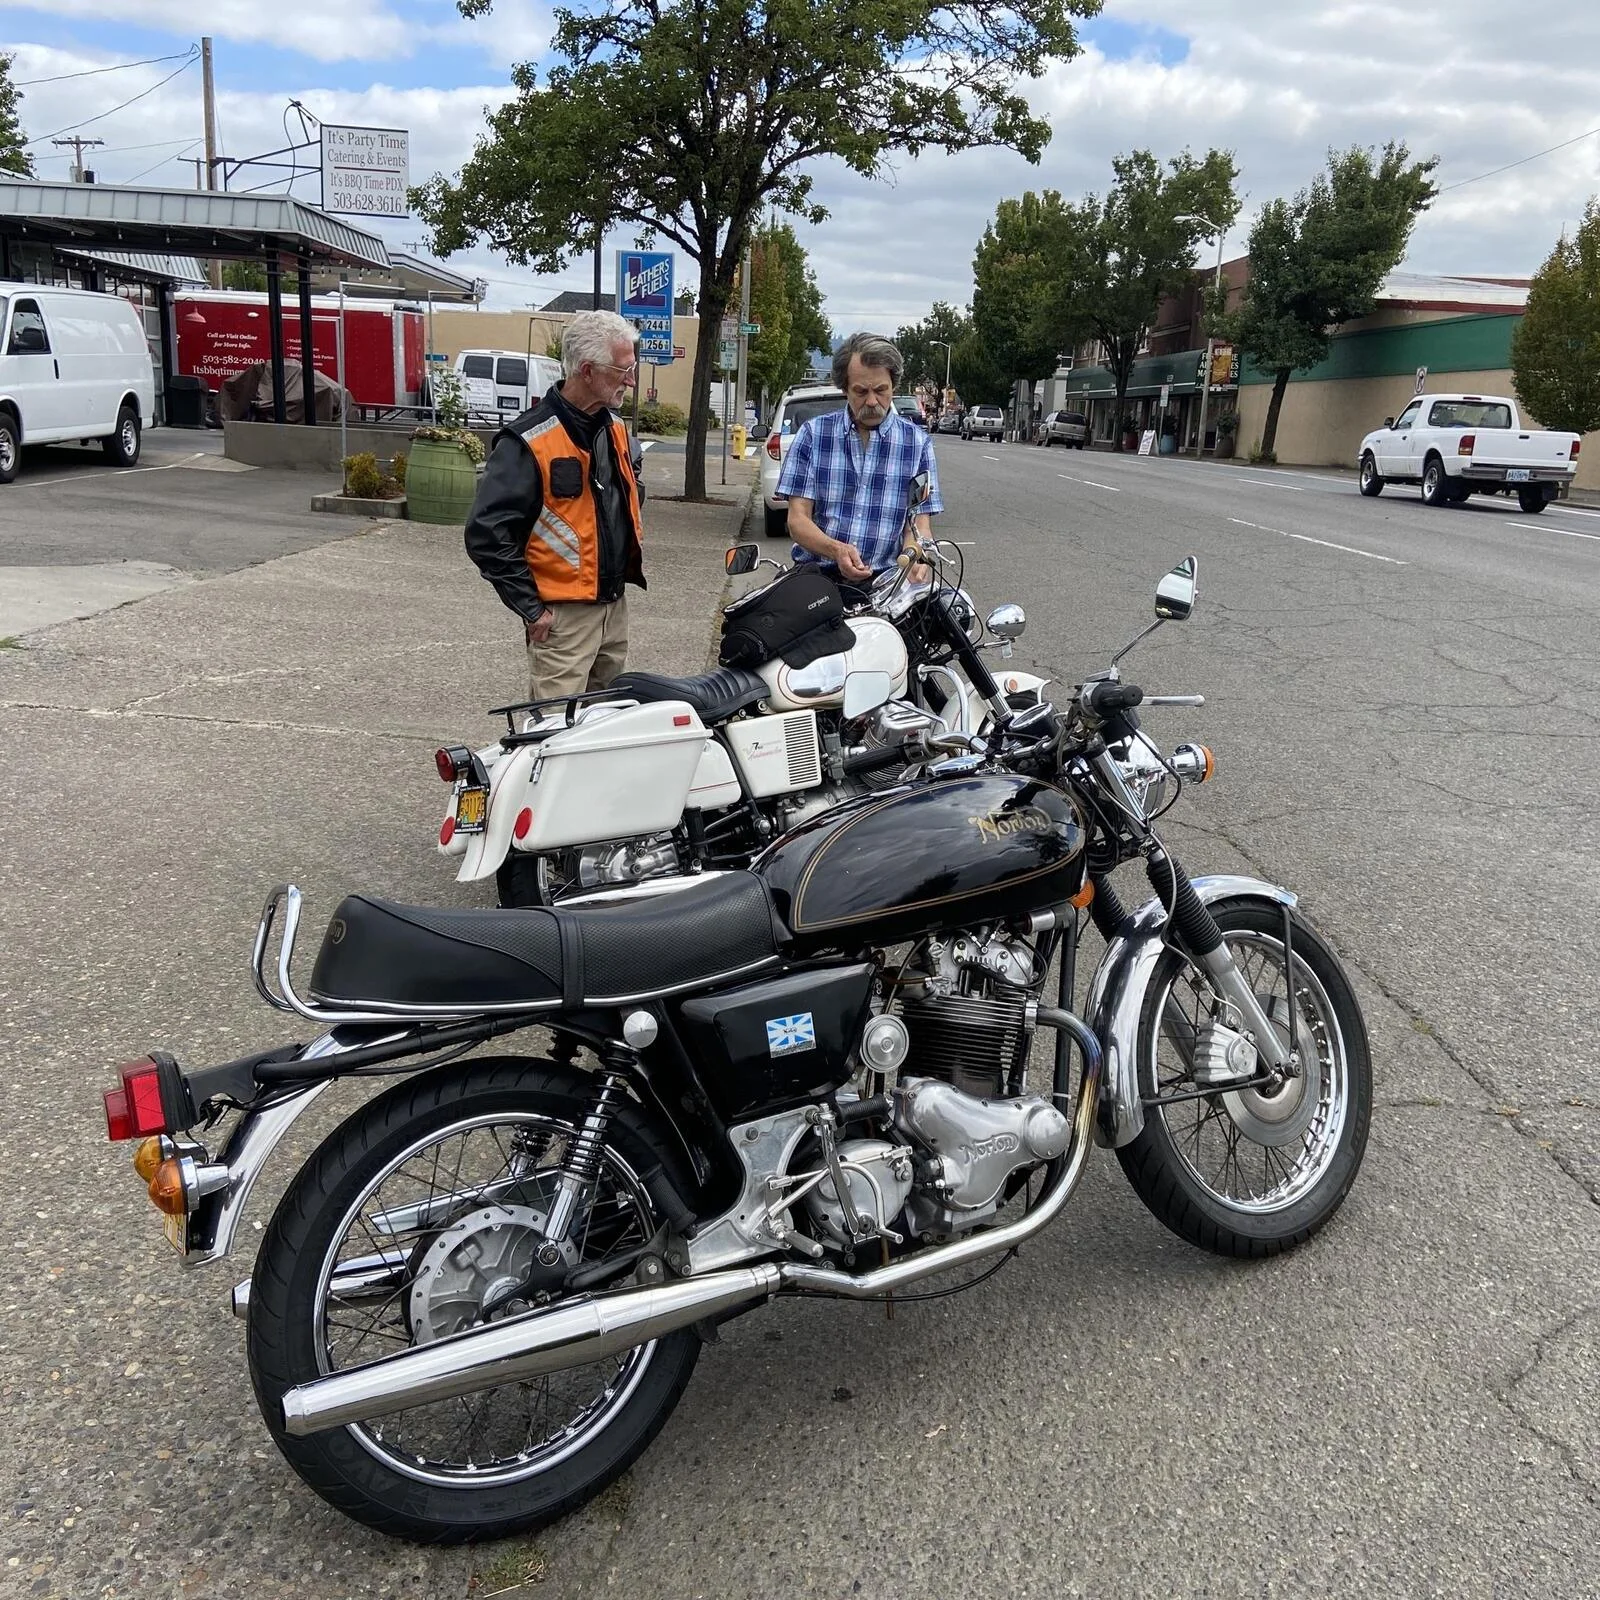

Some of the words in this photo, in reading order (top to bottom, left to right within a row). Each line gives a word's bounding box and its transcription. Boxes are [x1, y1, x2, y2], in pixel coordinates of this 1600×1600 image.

[328, 131, 344, 145] It's
[348, 132, 376, 149] Party
[378, 134, 406, 149] Time
[328, 149, 365, 167] Catering
[367, 152, 374, 165] &
[377, 152, 406, 167] Events
[330, 173, 342, 187] It's
[344, 174, 362, 191] BBQ
[364, 176, 384, 190] Time
[385, 177, 403, 191] PDX
[333, 192, 402, 213] 503-628-3616
[624, 258, 670, 301] LEATHERS
[641, 272, 670, 299] FUELS
[647, 320, 663, 330] 244
[647, 340, 664, 350] 256
[967, 806, 1052, 845] Norton
[958, 1132, 1020, 1165] Norton
